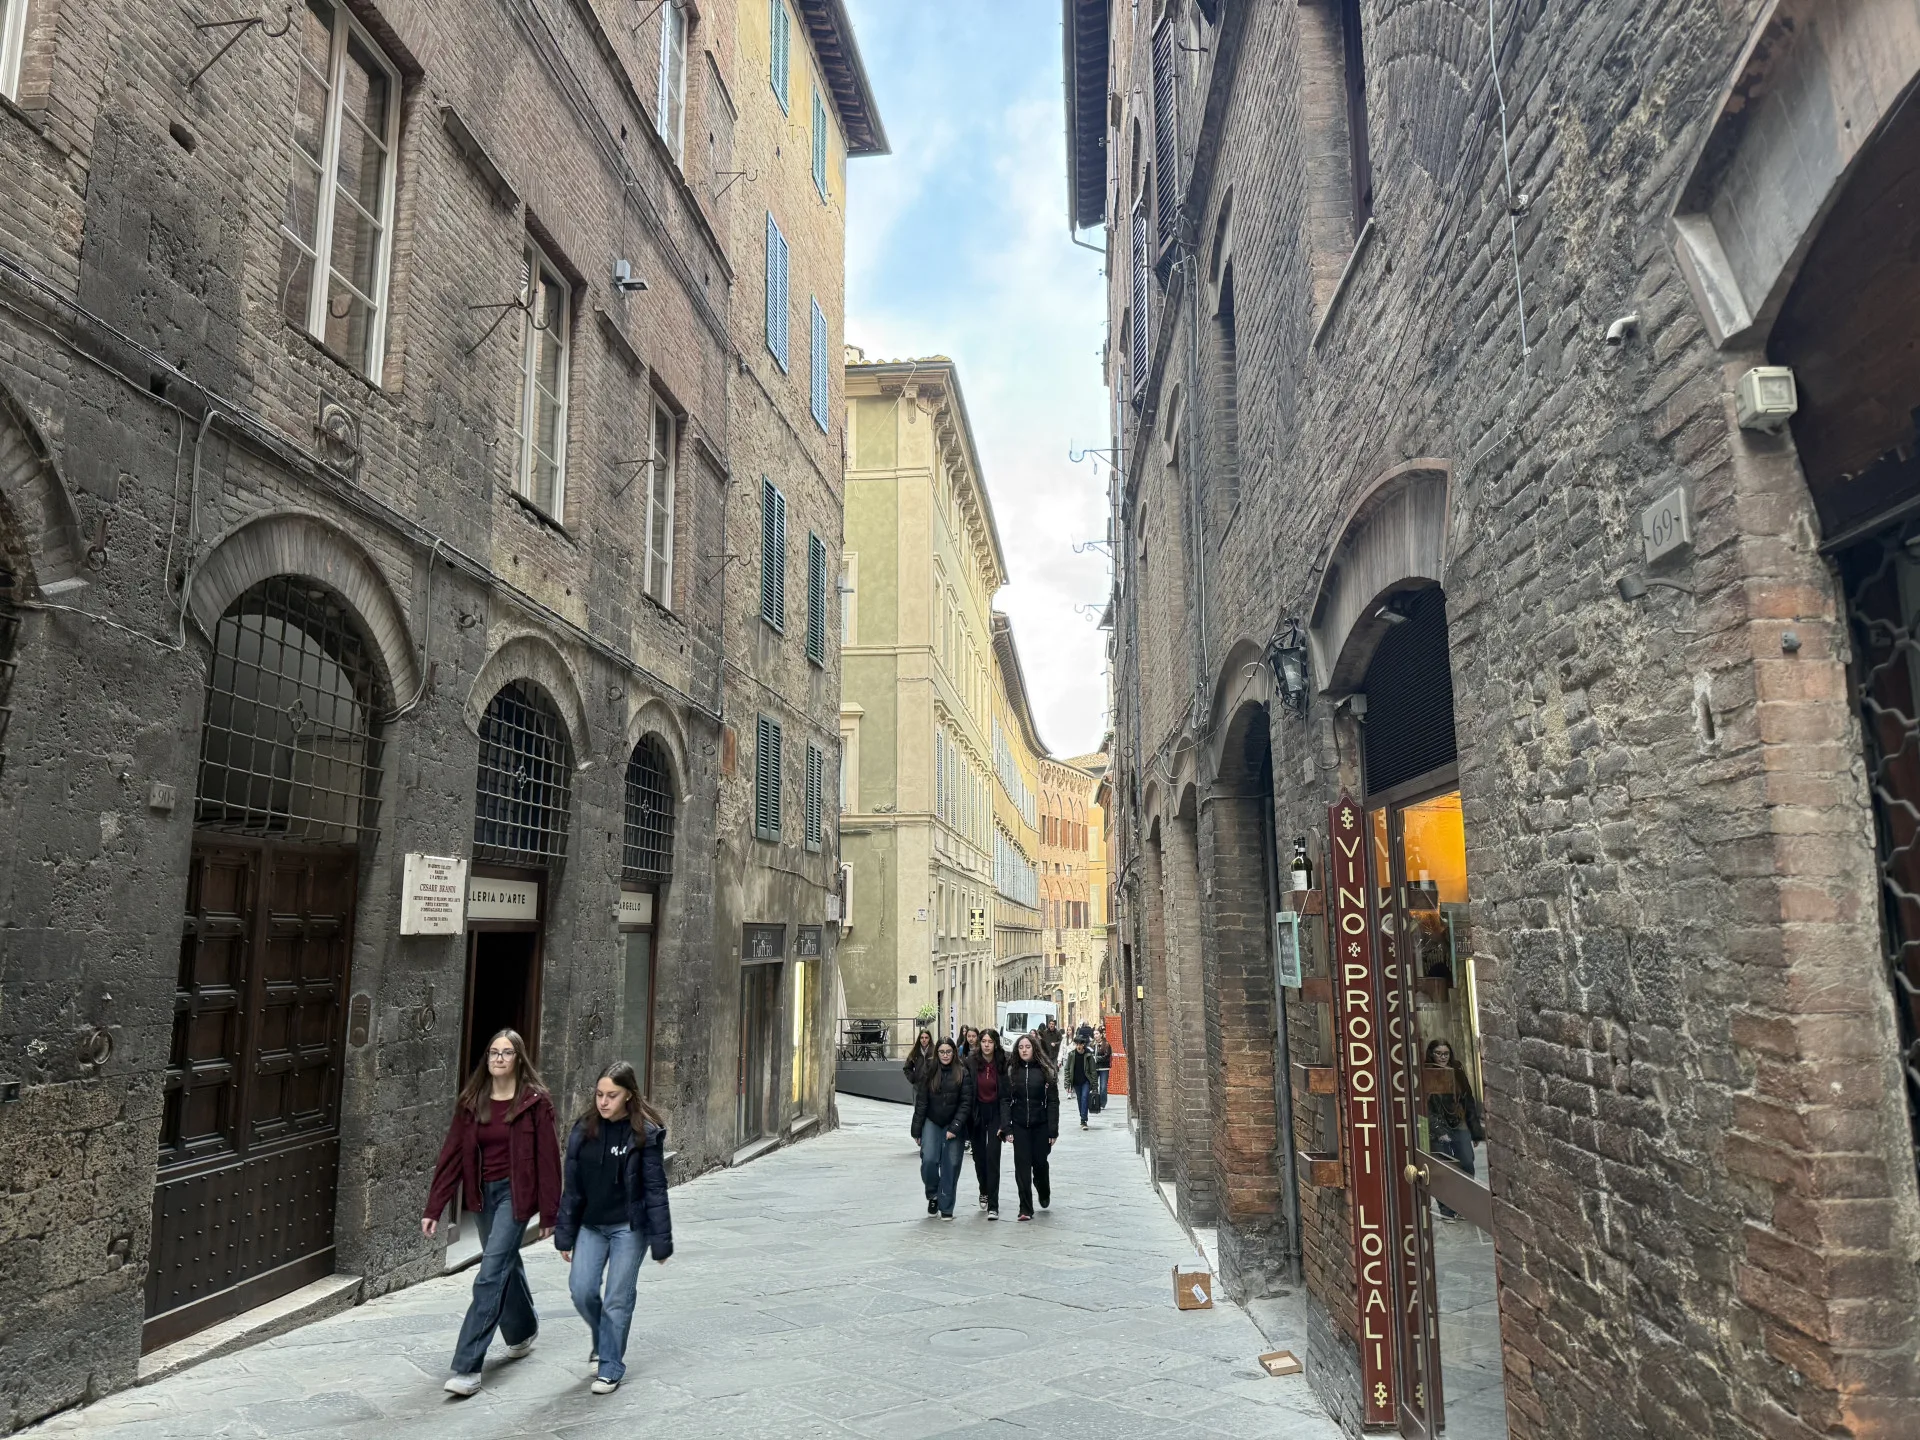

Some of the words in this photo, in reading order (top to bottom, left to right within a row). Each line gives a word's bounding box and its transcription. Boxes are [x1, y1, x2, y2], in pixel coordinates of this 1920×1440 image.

[1652, 508, 1673, 547] 69
[158, 789, 170, 803] 90
[500, 892, 526, 905] D'ARTE
[1336, 836, 1366, 935] VINO
[1344, 963, 1377, 1174] PRODOTTI
[1359, 1204, 1387, 1371] LOCALI
